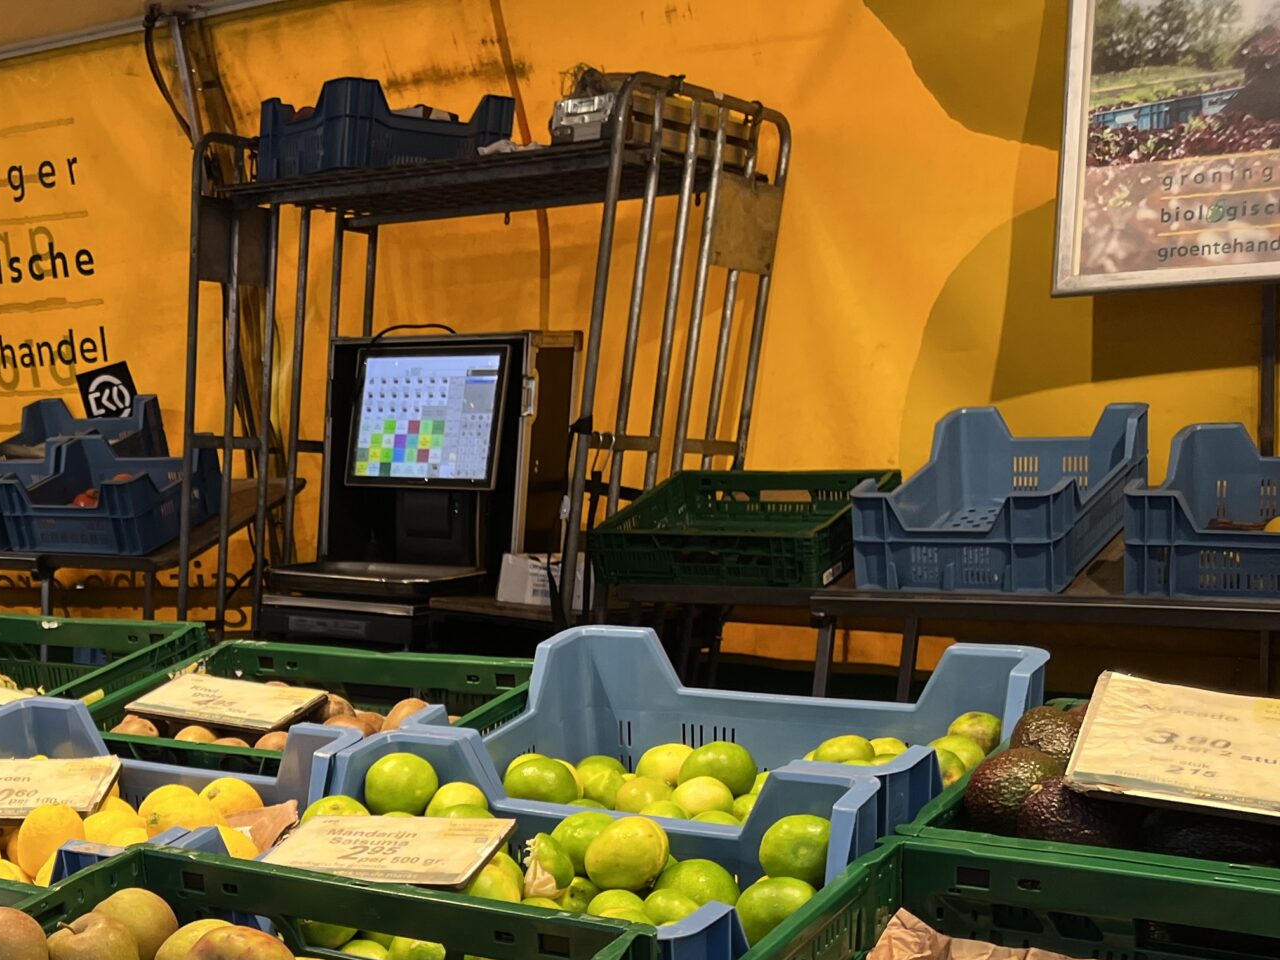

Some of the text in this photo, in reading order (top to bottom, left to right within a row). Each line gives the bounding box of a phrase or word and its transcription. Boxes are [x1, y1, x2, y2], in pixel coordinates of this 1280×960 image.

[1240, 753, 1280, 765] stu
[327, 828, 418, 840] Mandarijn
[329, 836, 410, 847] Satsuma
[390, 856, 420, 864] 500
